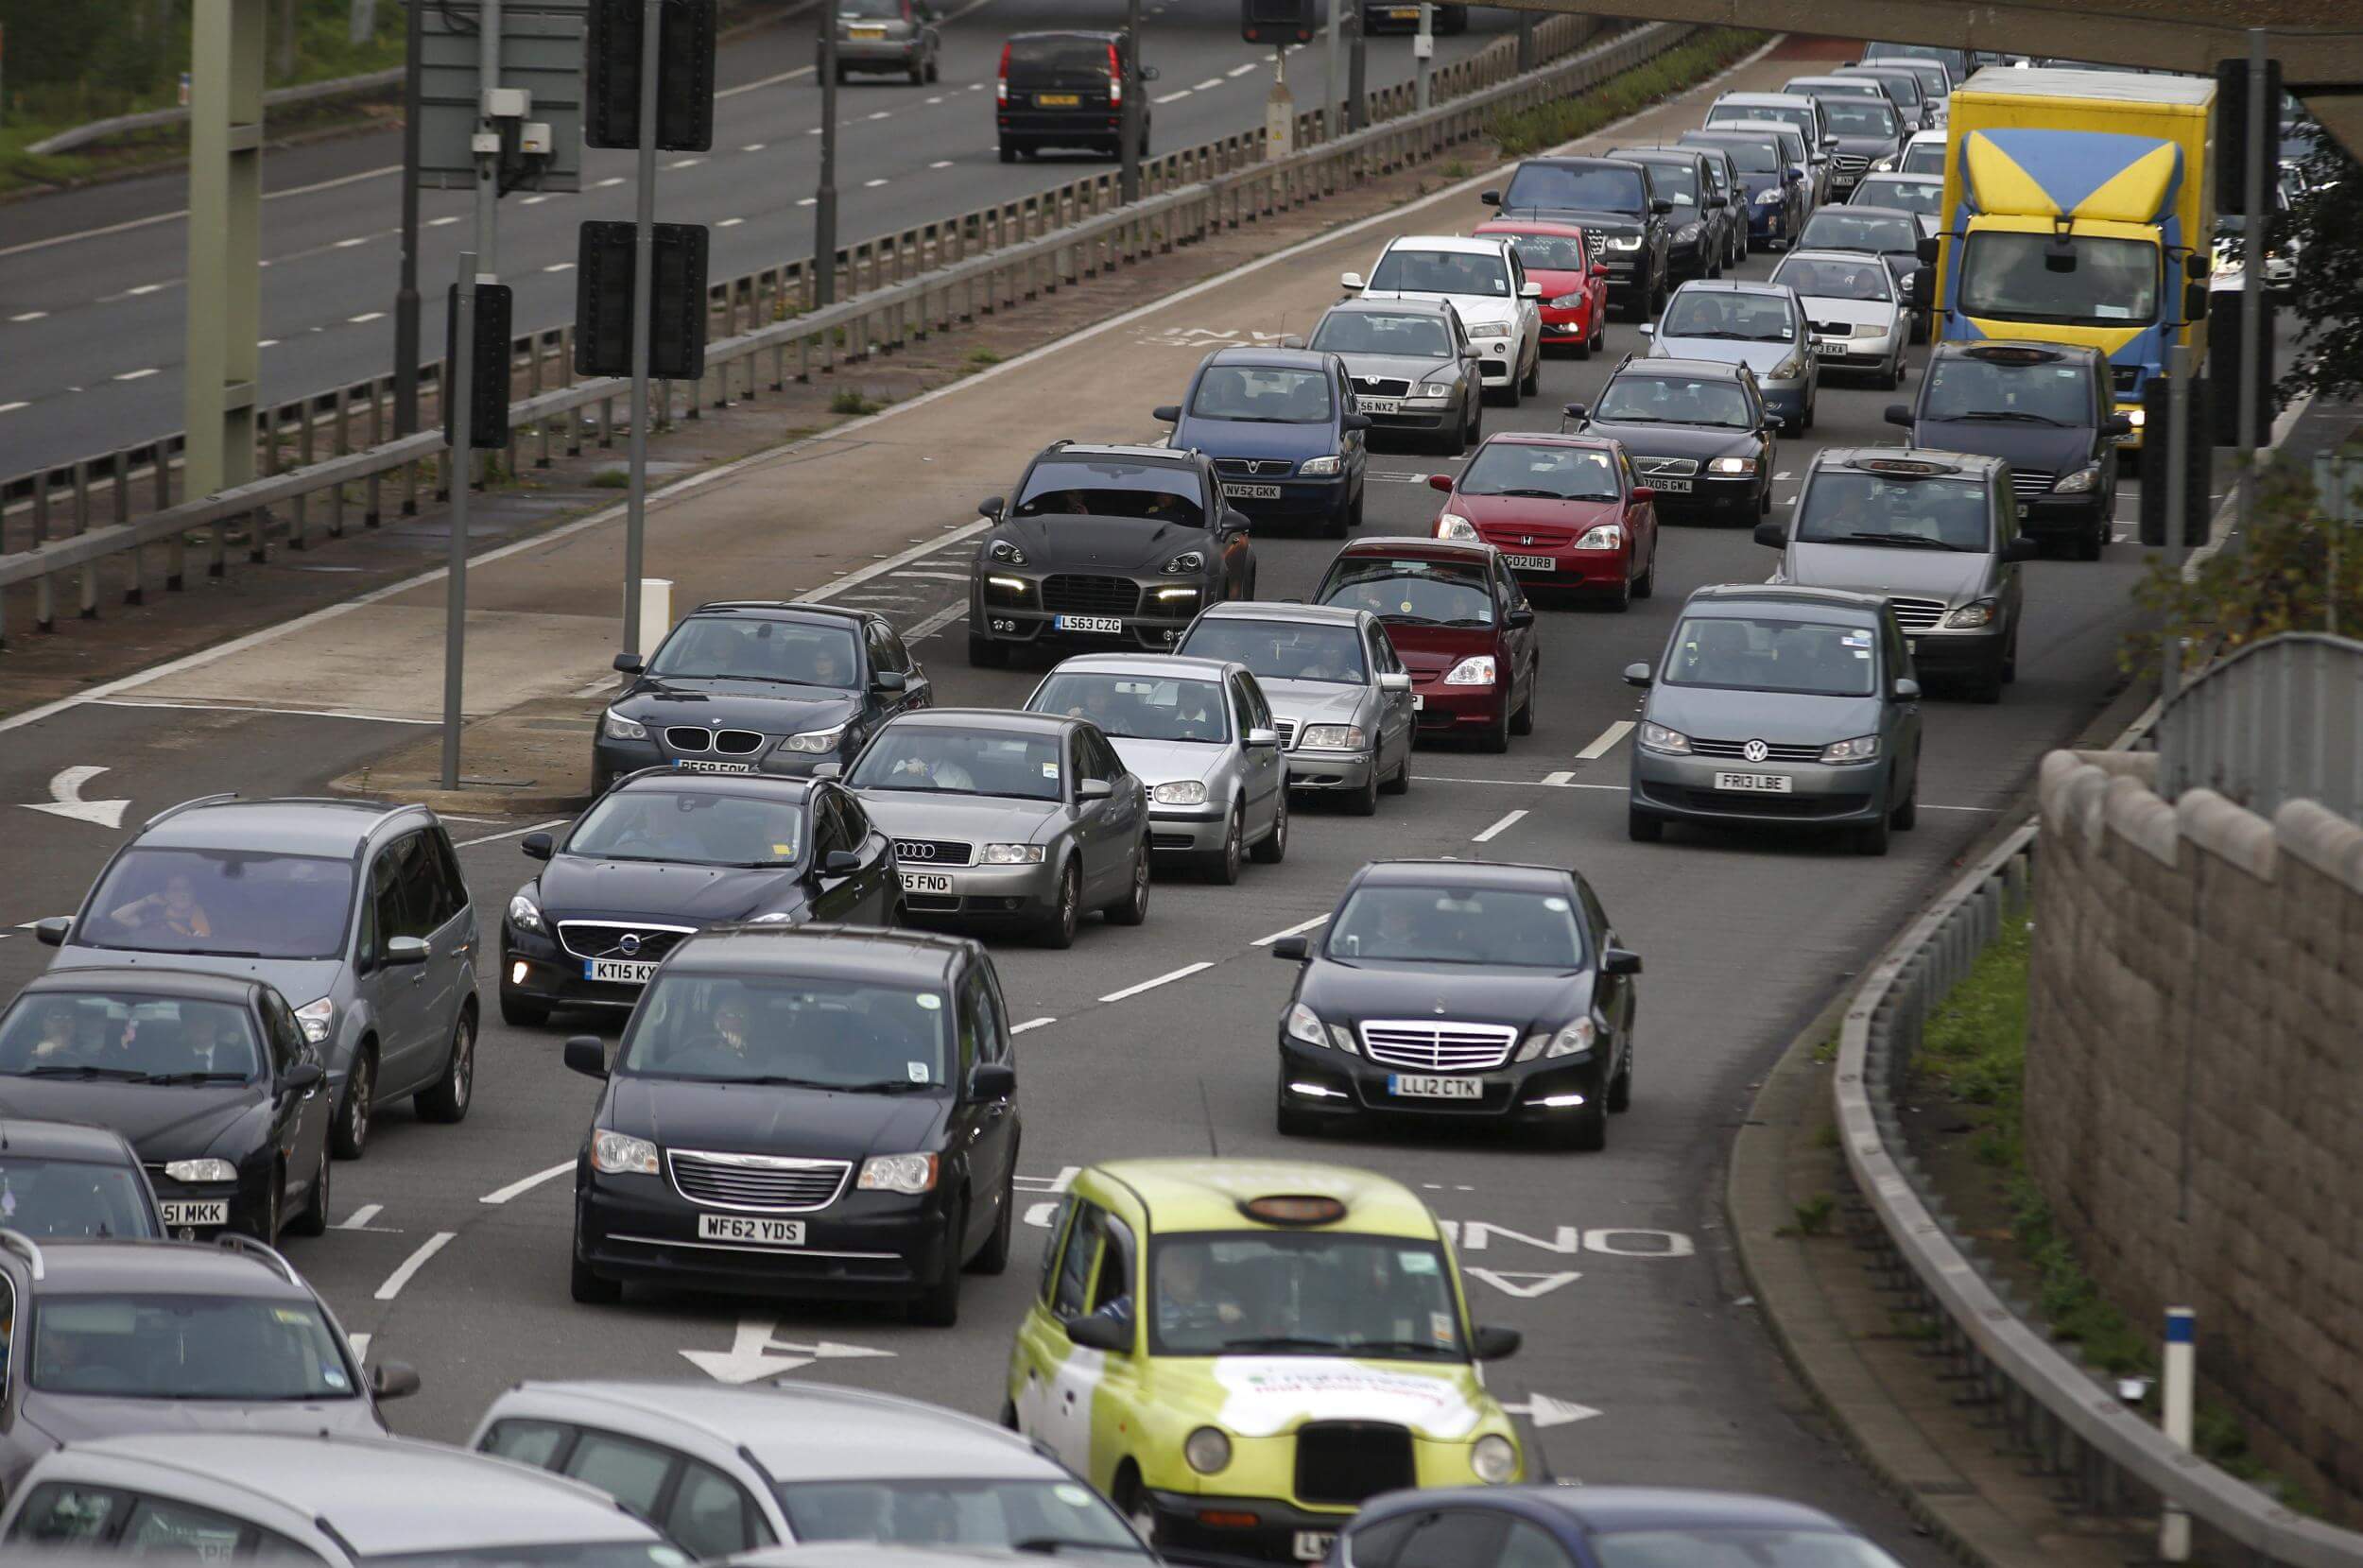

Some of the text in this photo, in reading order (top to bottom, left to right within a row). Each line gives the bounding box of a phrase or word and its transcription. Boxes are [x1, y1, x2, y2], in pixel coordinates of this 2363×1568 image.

[1226, 485, 1254, 496] NV52
[1529, 557, 1551, 569] URB
[1061, 616, 1120, 631] LS63 CZG
[1723, 774, 1752, 788] FR13
[917, 875, 946, 890] FNO
[597, 963, 632, 979] KT15
[1402, 1077, 1475, 1095] LL12 CTK
[185, 1204, 220, 1221] MKK
[707, 1216, 798, 1241] WF62 YDS
